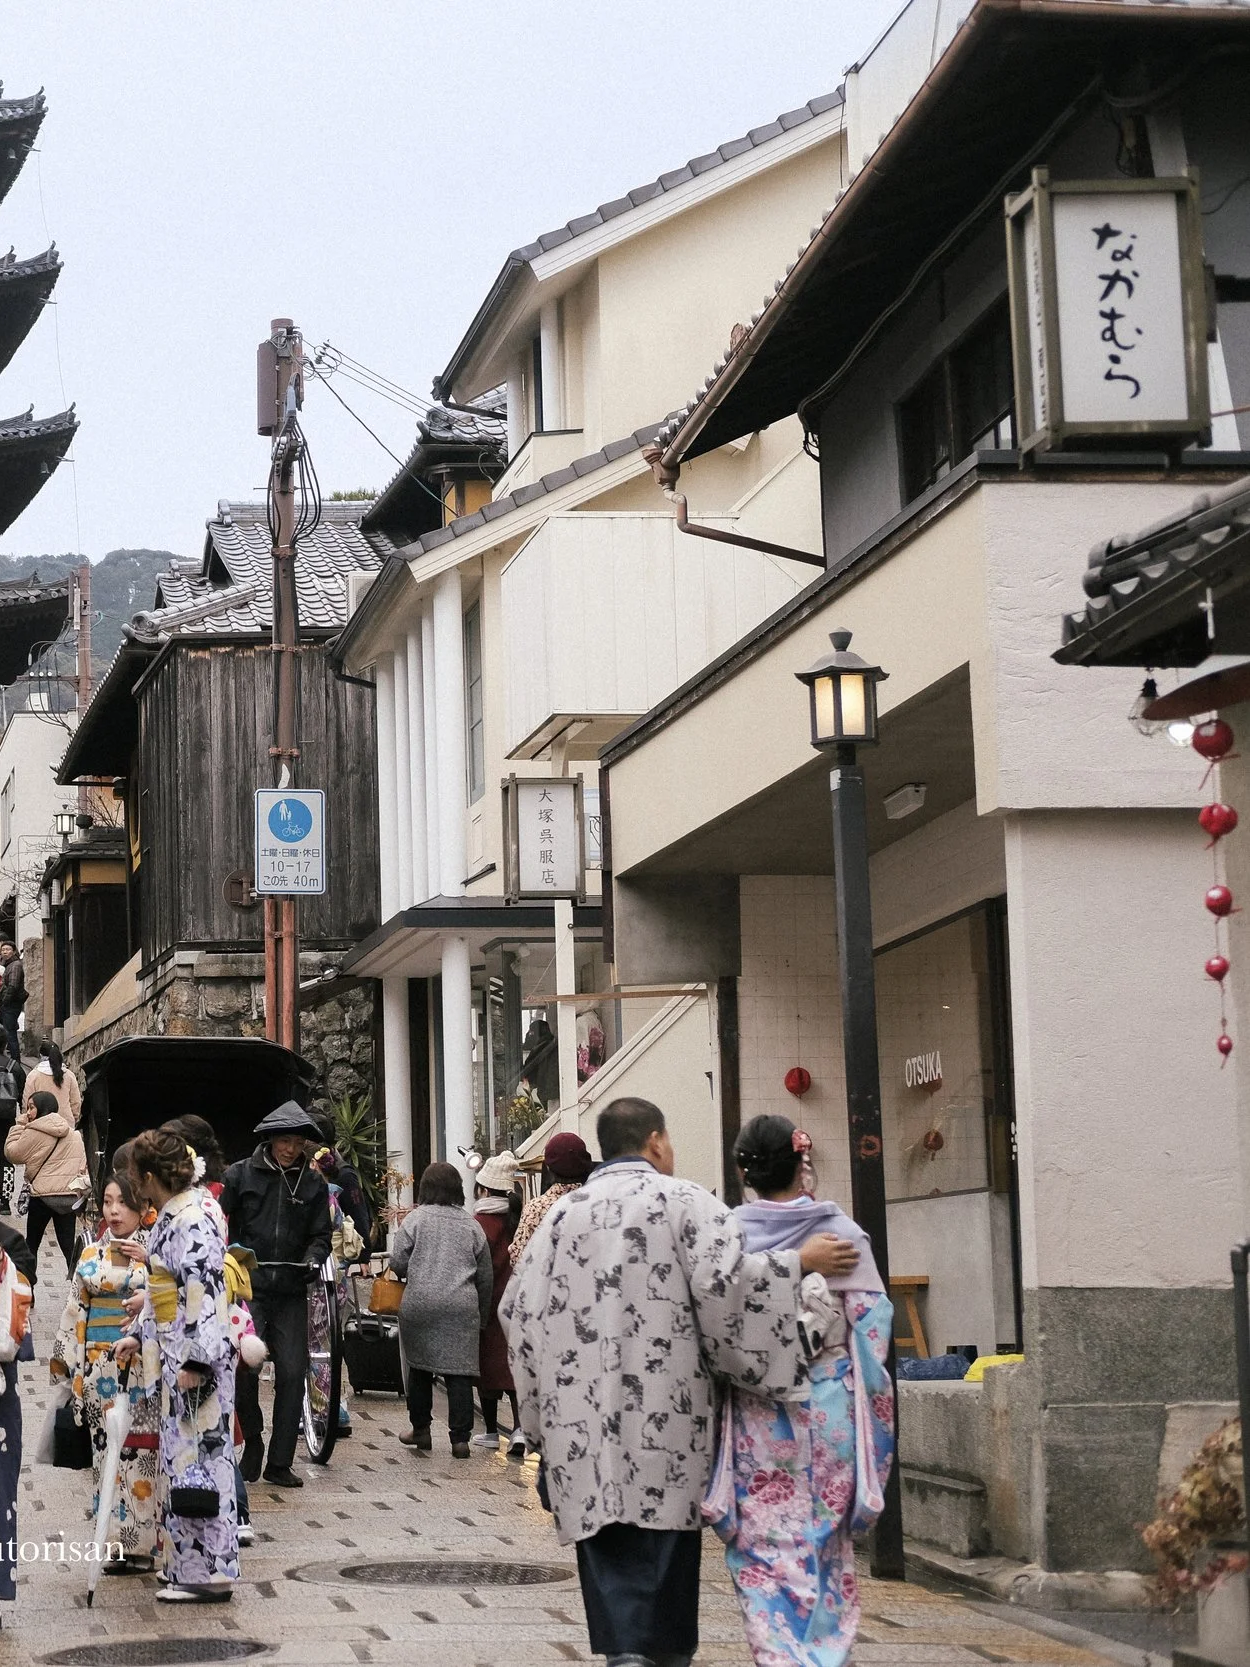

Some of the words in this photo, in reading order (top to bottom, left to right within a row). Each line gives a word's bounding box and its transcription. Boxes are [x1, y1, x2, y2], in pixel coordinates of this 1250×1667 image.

[1091, 222, 1143, 399] なかむら
[263, 875, 289, 887] この先
[293, 875, 319, 887] 40m
[905, 1050, 943, 1088] OTSUKA
